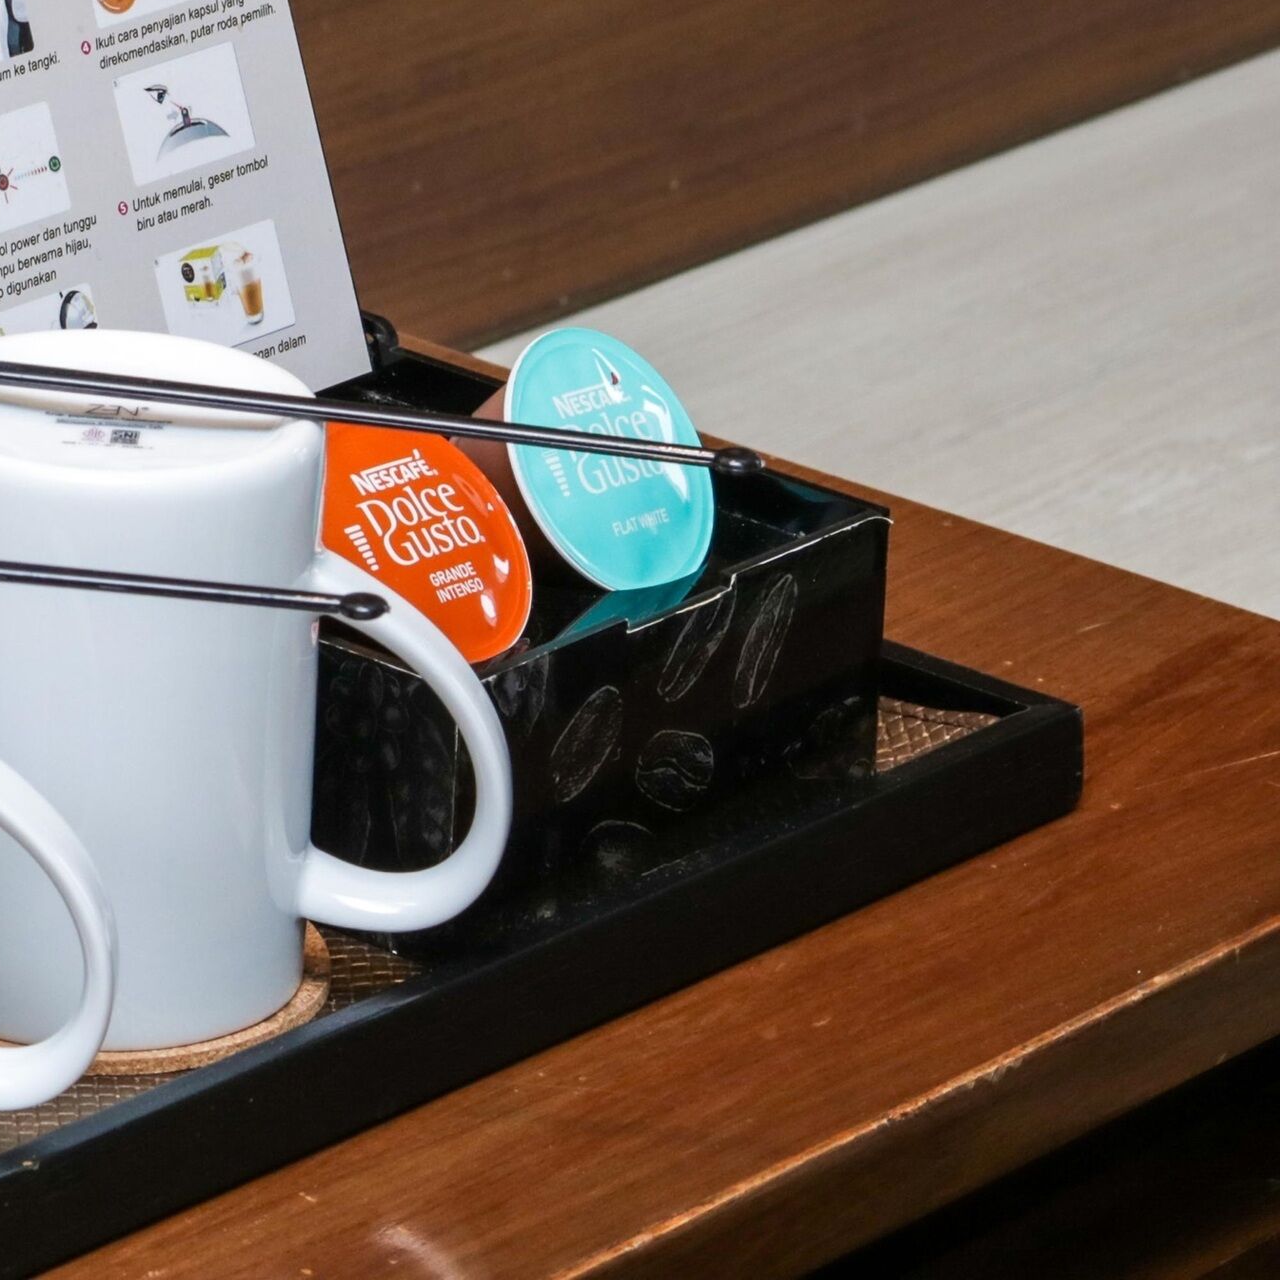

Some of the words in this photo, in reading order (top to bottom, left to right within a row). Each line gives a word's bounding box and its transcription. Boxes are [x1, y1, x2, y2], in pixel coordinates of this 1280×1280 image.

[95, 32, 116, 50] Ikuti
[117, 27, 139, 44] cara
[140, 13, 186, 38] penyajian
[188, 0, 220, 22] kapsul
[99, 32, 189, 70] direkomendasikan,
[190, 22, 215, 44] putar
[216, 14, 239, 31] roda
[239, 2, 277, 28] pemilih.
[13, 61, 26, 77] ke
[27, 51, 61, 72] tangki.
[132, 191, 161, 213] Untuk
[163, 176, 206, 202] memulai,
[207, 167, 235, 189] geser
[236, 155, 269, 178] tombol
[136, 215, 155, 232] biru
[157, 209, 179, 225] atau
[180, 196, 214, 218] merah.
[10, 233, 41, 255] power
[43, 224, 62, 242] dan
[63, 214, 98, 235] tunggu
[65, 237, 92, 257] hijau,
[6, 270, 57, 298] digunakan
[278, 334, 307, 353] dalam
[552, 372, 631, 419] NESCA
[355, 483, 465, 537] Dolce
[612, 514, 637, 537] FLAT
[383, 512, 483, 566] Gusto
[429, 561, 477, 587] GRANDE
[436, 577, 484, 604] INTENSO
